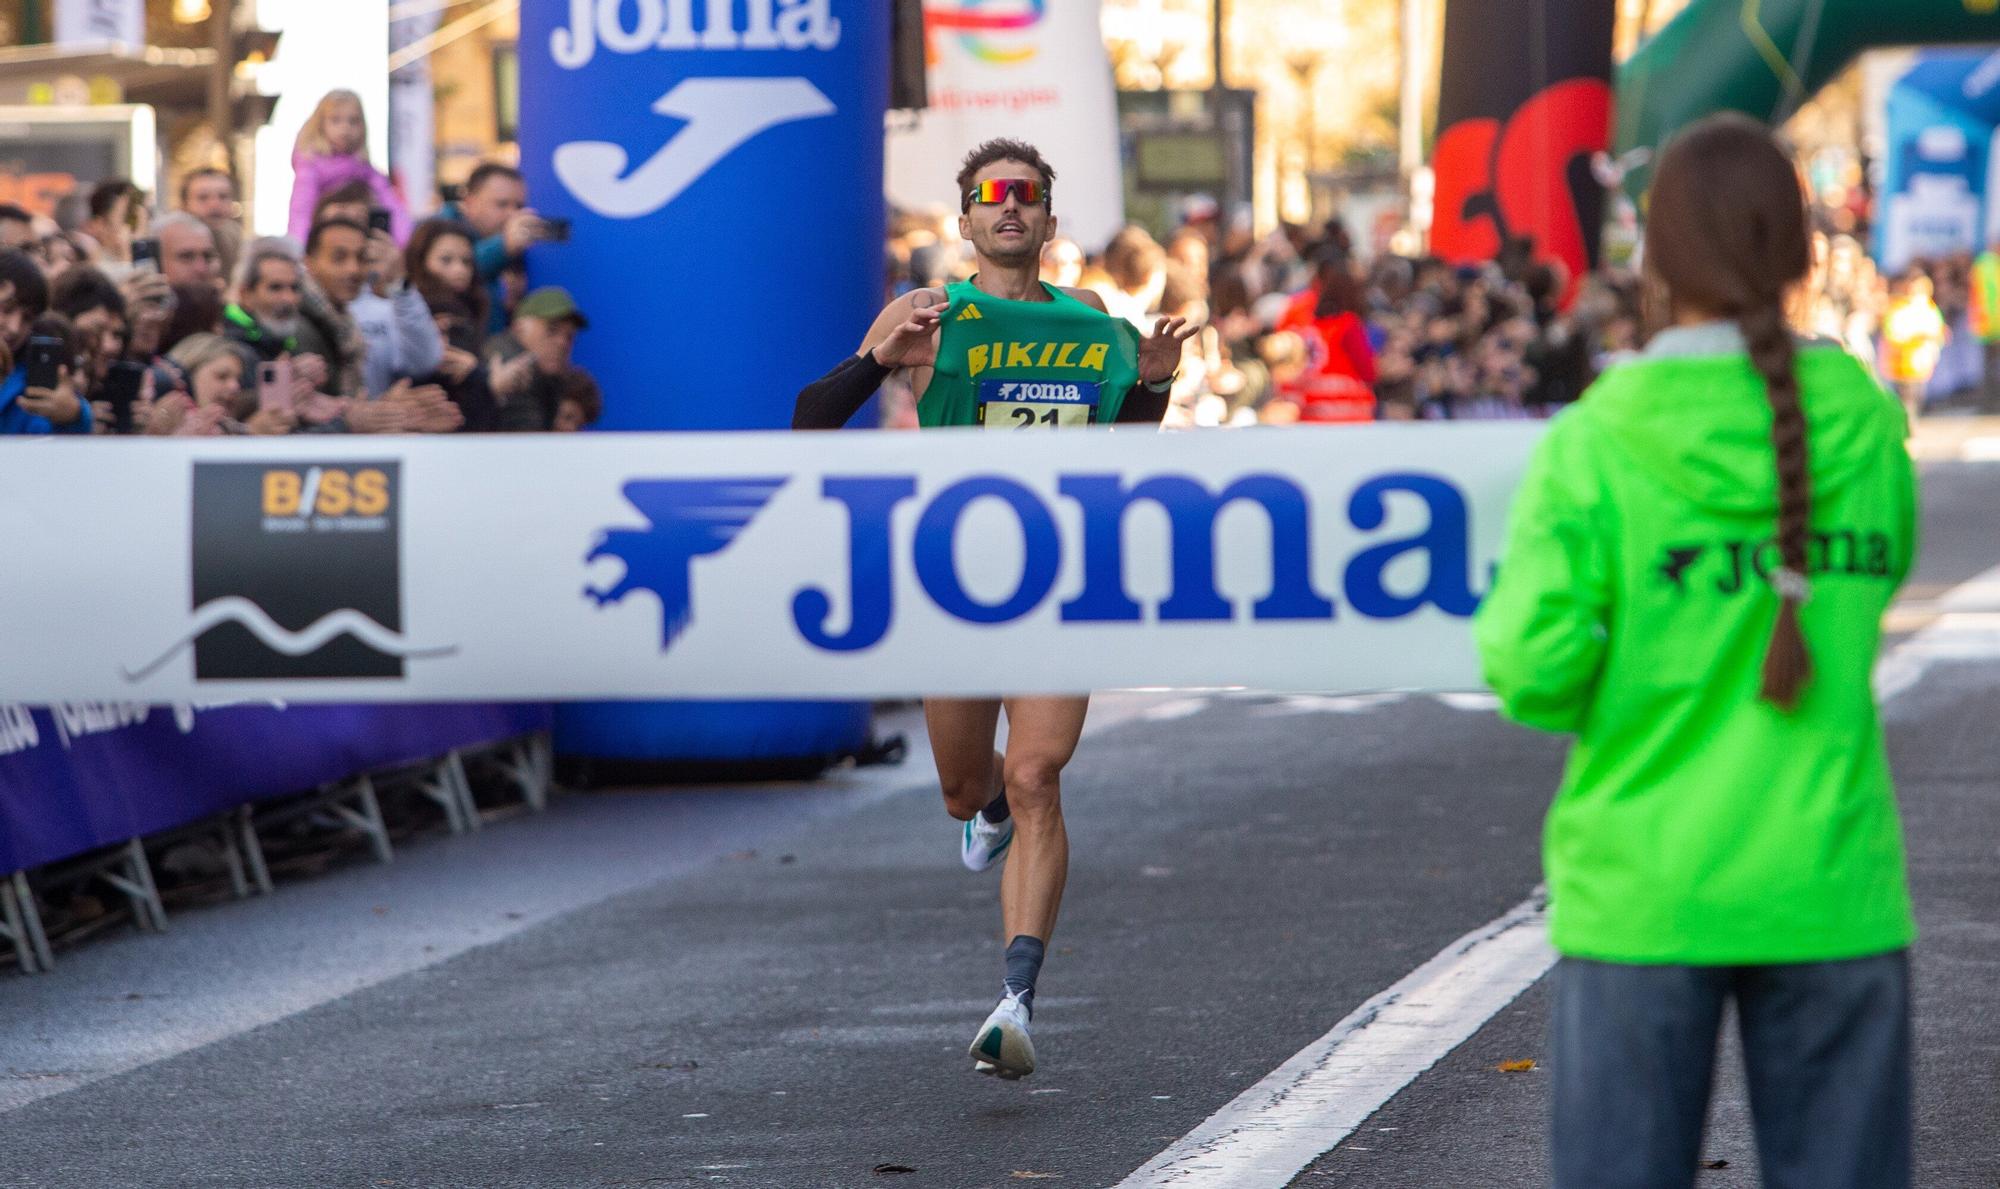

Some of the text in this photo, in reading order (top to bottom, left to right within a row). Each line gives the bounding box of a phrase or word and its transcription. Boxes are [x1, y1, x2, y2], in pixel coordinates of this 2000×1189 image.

[967, 342, 1110, 377] BIKILA
[1016, 383, 1081, 401] Joma
[1011, 407, 1059, 431] 21
[791, 470, 1493, 652] Joma
